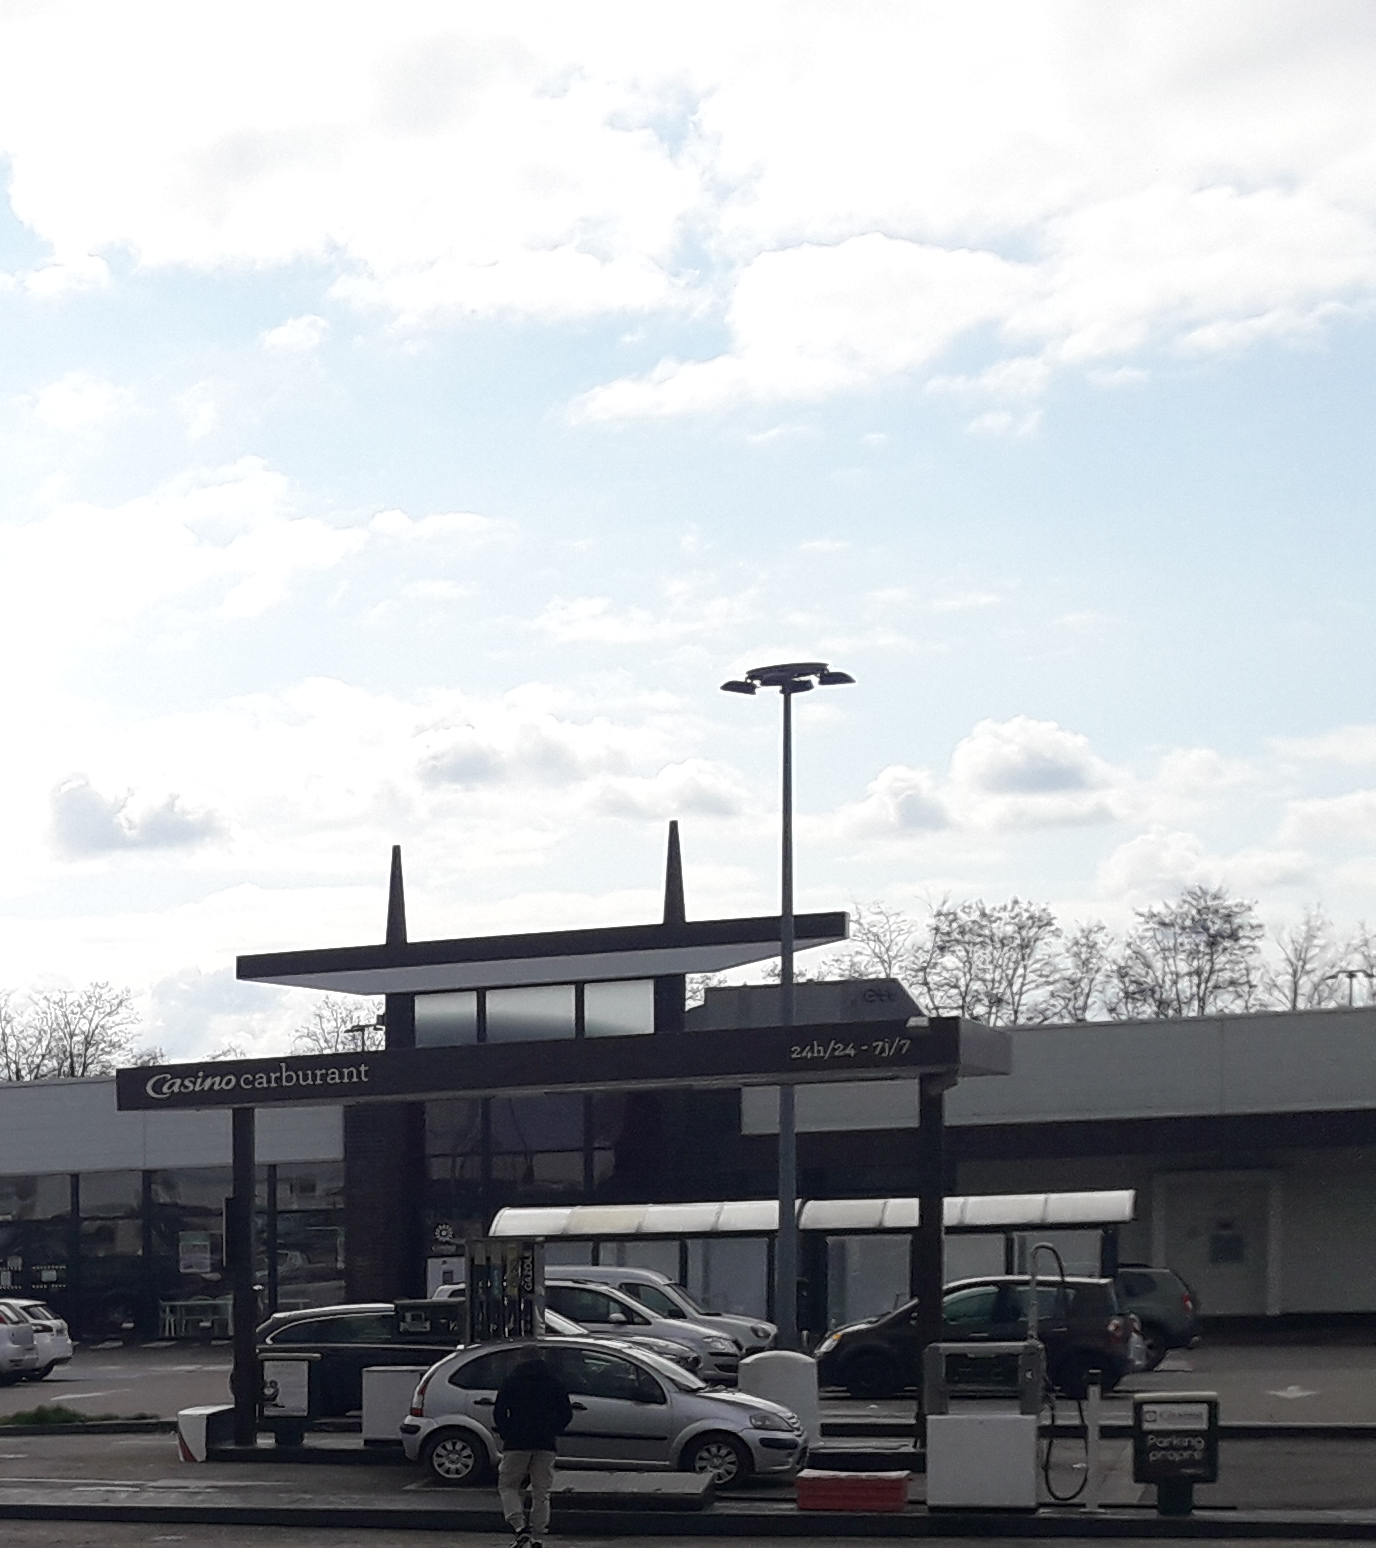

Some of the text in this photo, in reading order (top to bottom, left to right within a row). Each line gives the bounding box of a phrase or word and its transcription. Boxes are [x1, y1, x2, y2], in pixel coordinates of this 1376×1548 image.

[791, 1040, 856, 1060] 24h/24
[872, 1037, 911, 1057] 7j/7
[146, 1062, 369, 1099] Casino carburant
